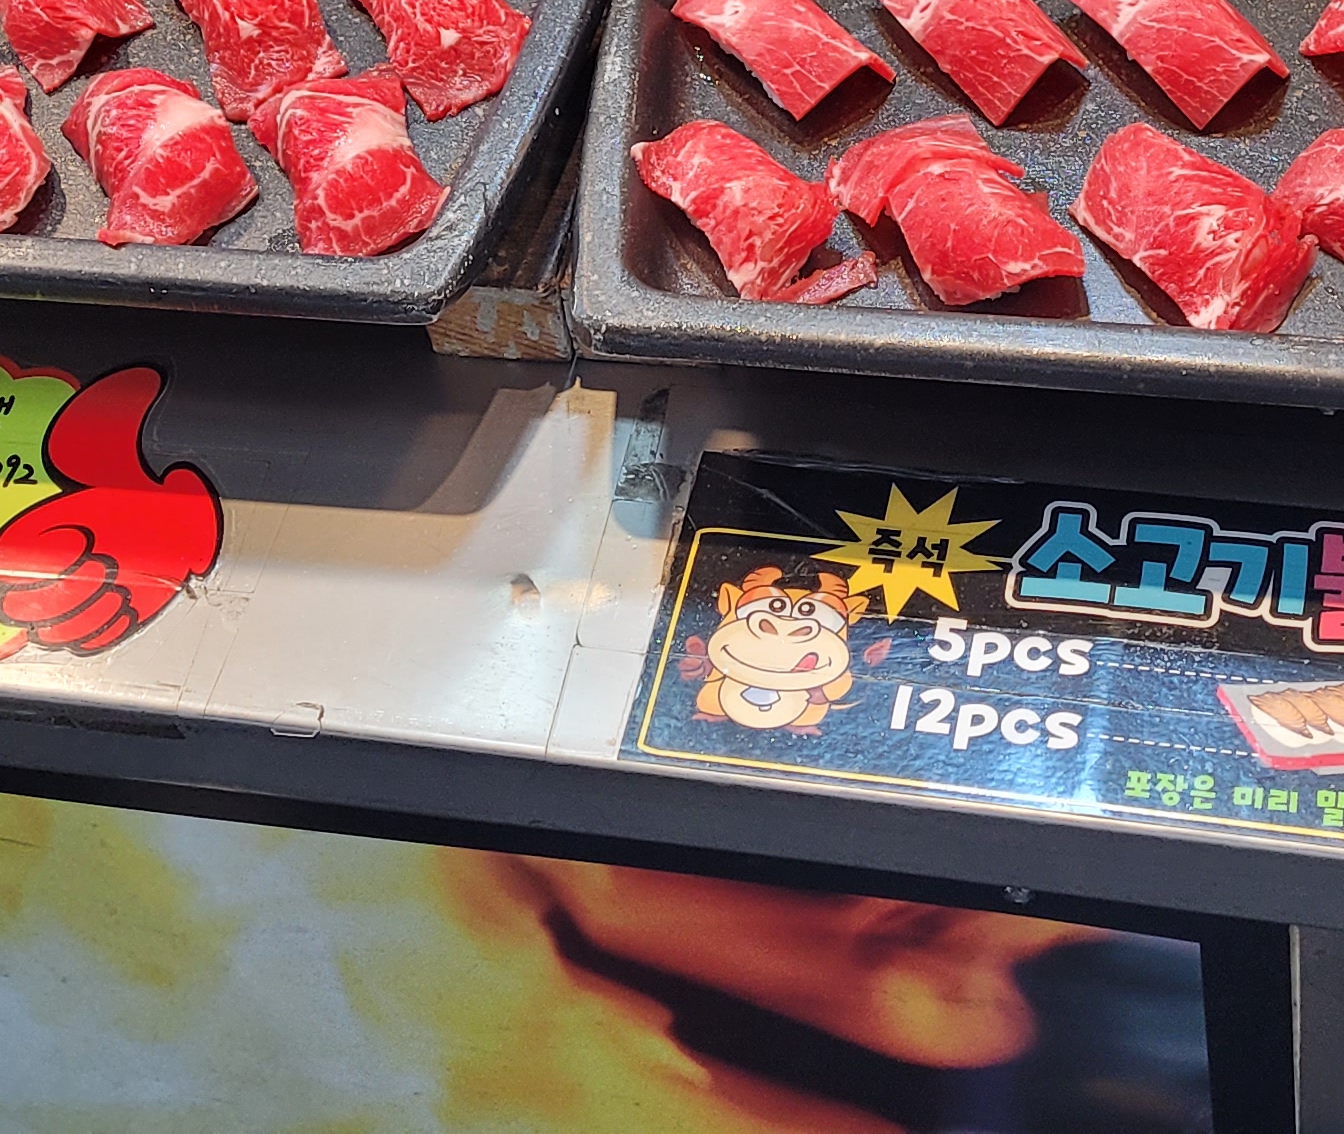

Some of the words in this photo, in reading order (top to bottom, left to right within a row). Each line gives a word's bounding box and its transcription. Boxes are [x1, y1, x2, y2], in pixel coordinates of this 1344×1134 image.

[867, 527, 950, 578] 즉석
[927, 616, 1095, 678] 5pcs
[889, 684, 1084, 751] 12pcs
[1123, 769, 1217, 811] 포장은
[1232, 786, 1299, 815] 미리
